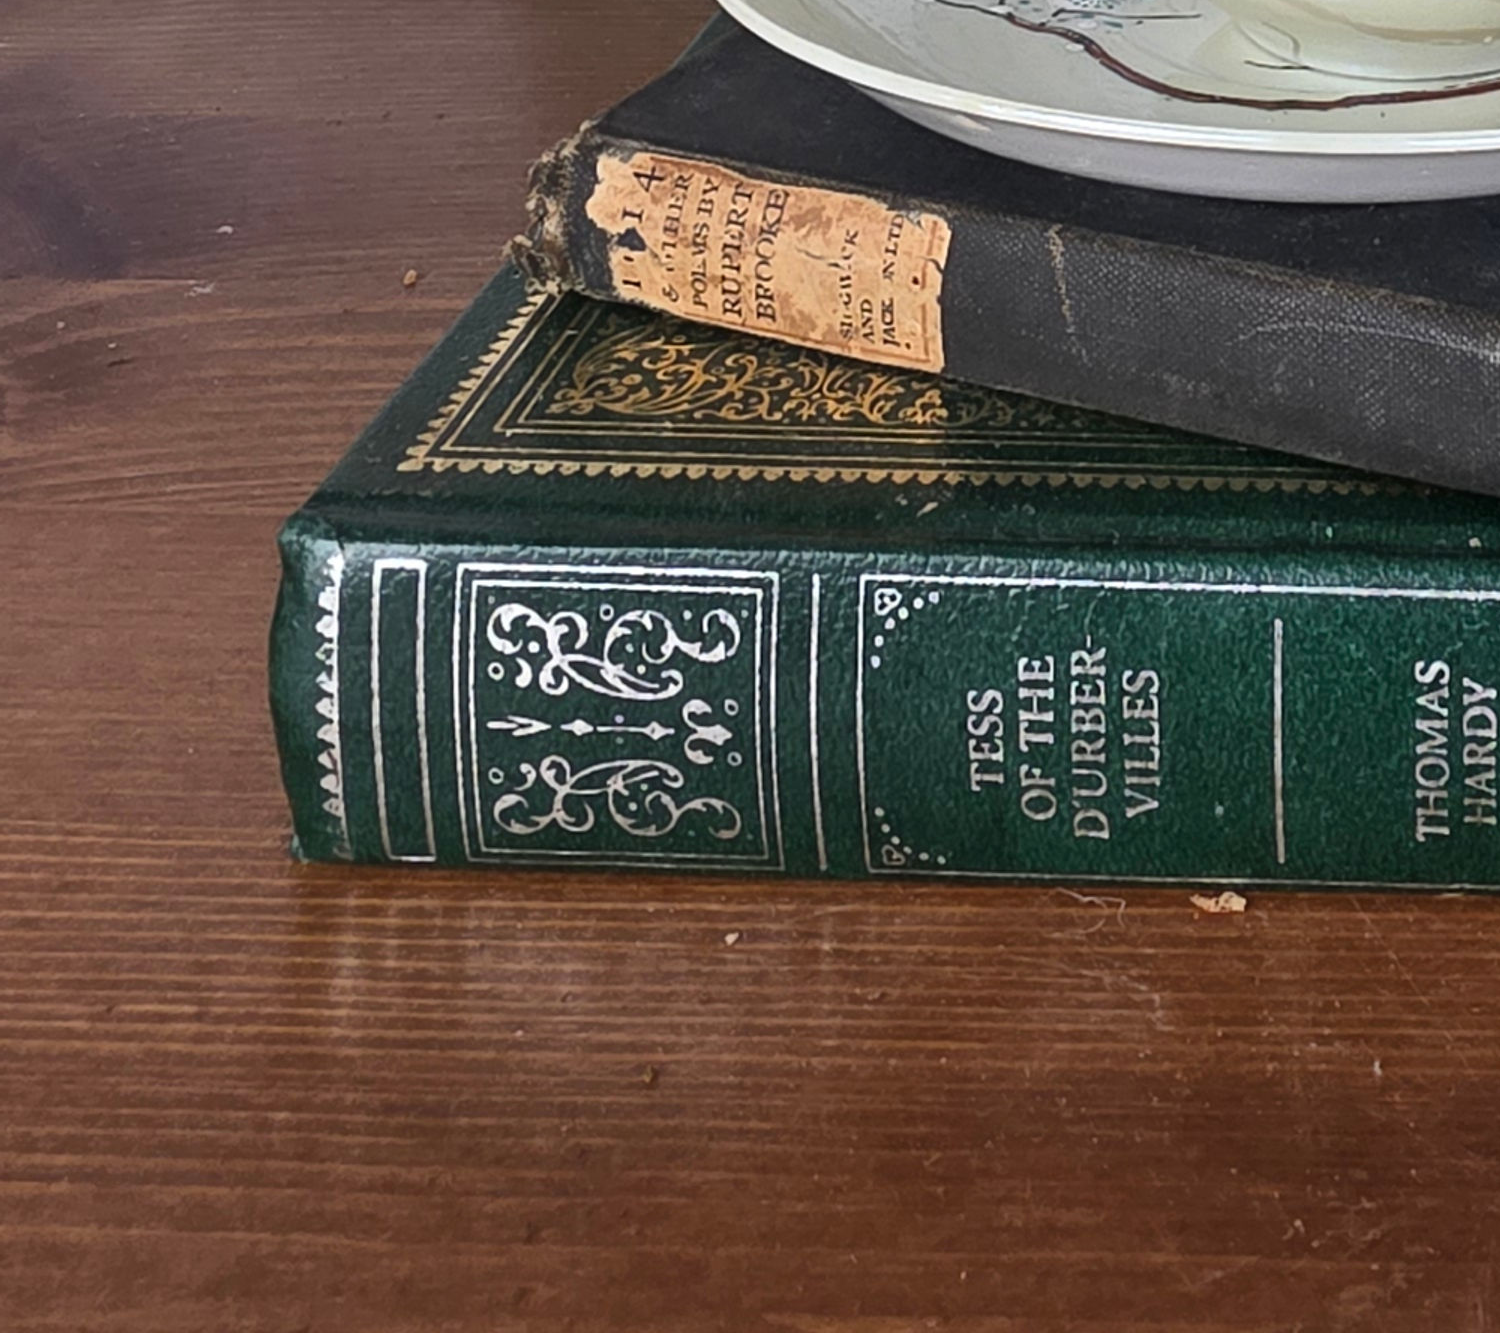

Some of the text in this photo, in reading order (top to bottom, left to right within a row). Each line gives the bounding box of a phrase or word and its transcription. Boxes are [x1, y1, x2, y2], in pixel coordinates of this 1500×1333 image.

[622, 164, 667, 292] 114
[696, 177, 722, 218] BY
[721, 182, 757, 320] RUPERT
[753, 188, 791, 323] BROOKE
[661, 287, 680, 304] &
[856, 297, 877, 345] AND
[966, 687, 1006, 793] TESS
[1018, 654, 1059, 822] OF THE
[1070, 634, 1111, 841] D'URBER-
[1122, 667, 1162, 819] VILLES
[1413, 658, 1453, 844] THOMAS
[1461, 675, 1500, 828] HARDY
